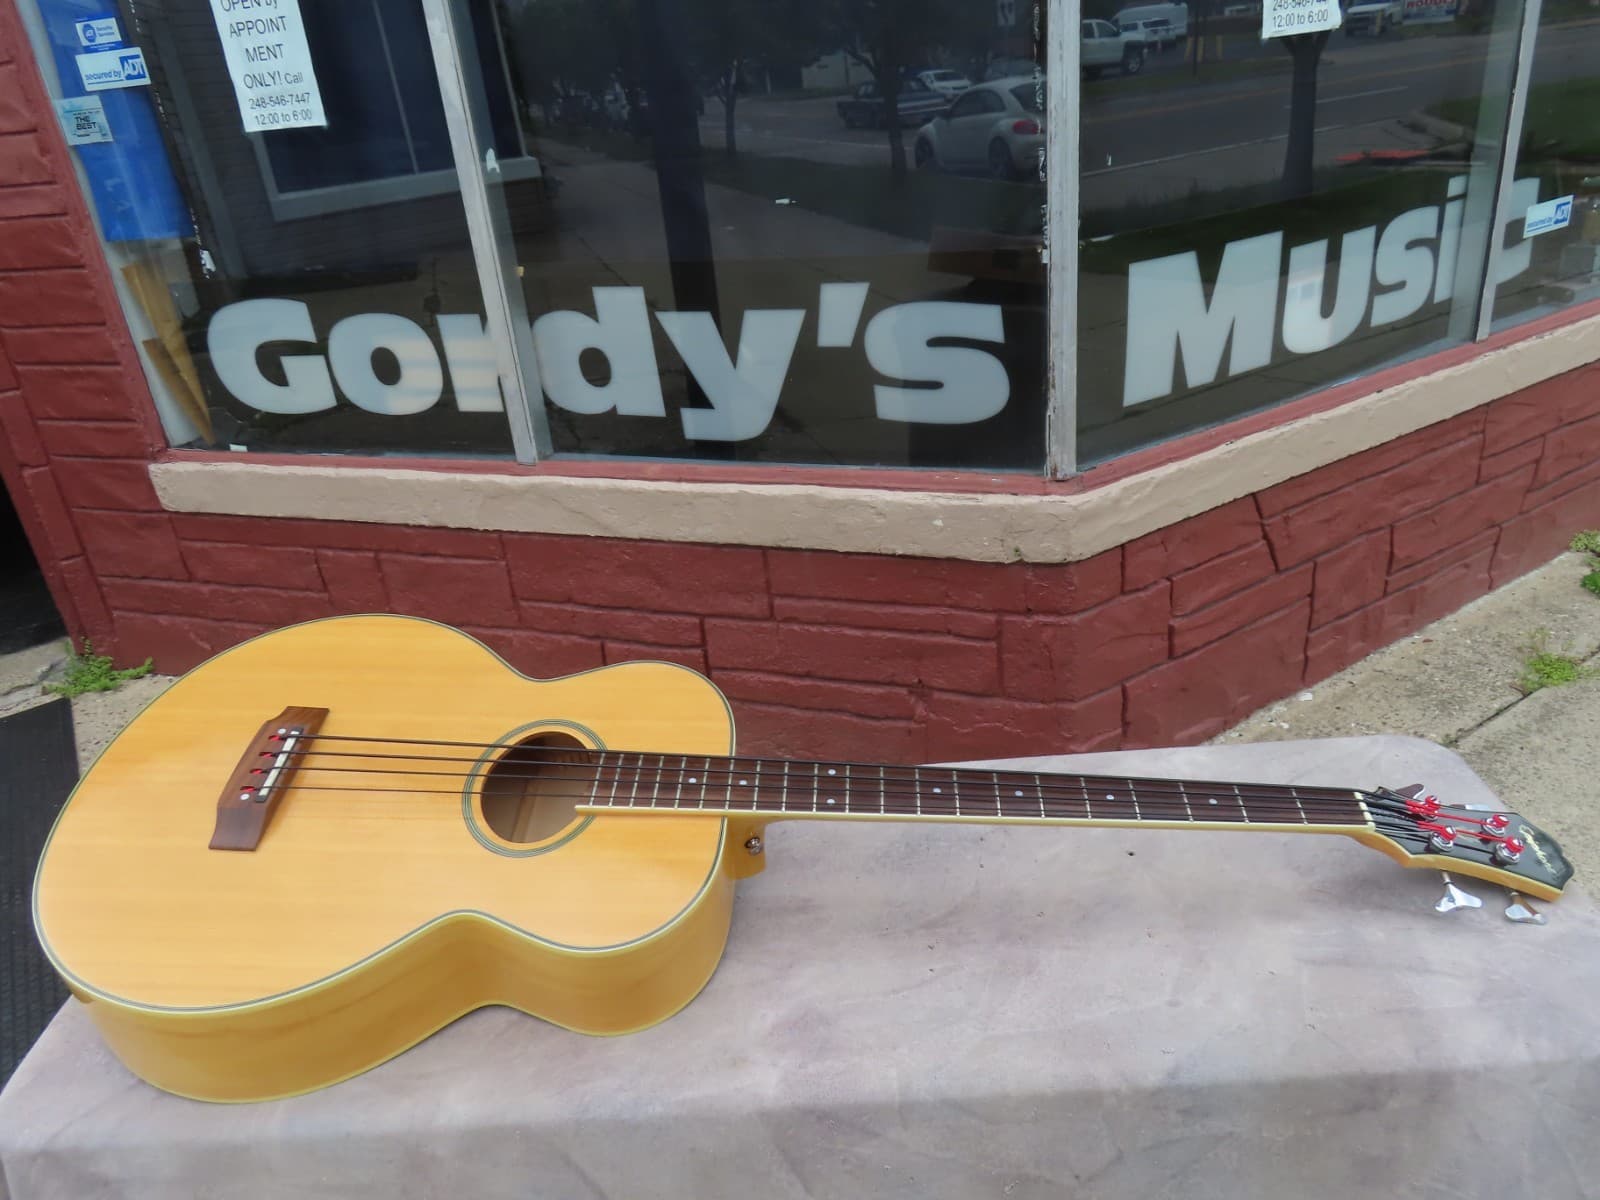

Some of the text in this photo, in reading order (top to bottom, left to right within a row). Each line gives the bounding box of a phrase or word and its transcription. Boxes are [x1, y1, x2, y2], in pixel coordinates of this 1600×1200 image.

[229, 15, 287, 38] APPOINT
[1272, 9, 1329, 28] 12:00 to 6:00
[244, 43, 284, 63] MENT
[85, 70, 112, 81] secured
[120, 56, 146, 78] ADT
[243, 69, 304, 89] ONLY! Call
[248, 91, 311, 111] 248-546-7447
[255, 108, 313, 126] 12:00 to 6:00
[207, 281, 1011, 442] Gordy's
